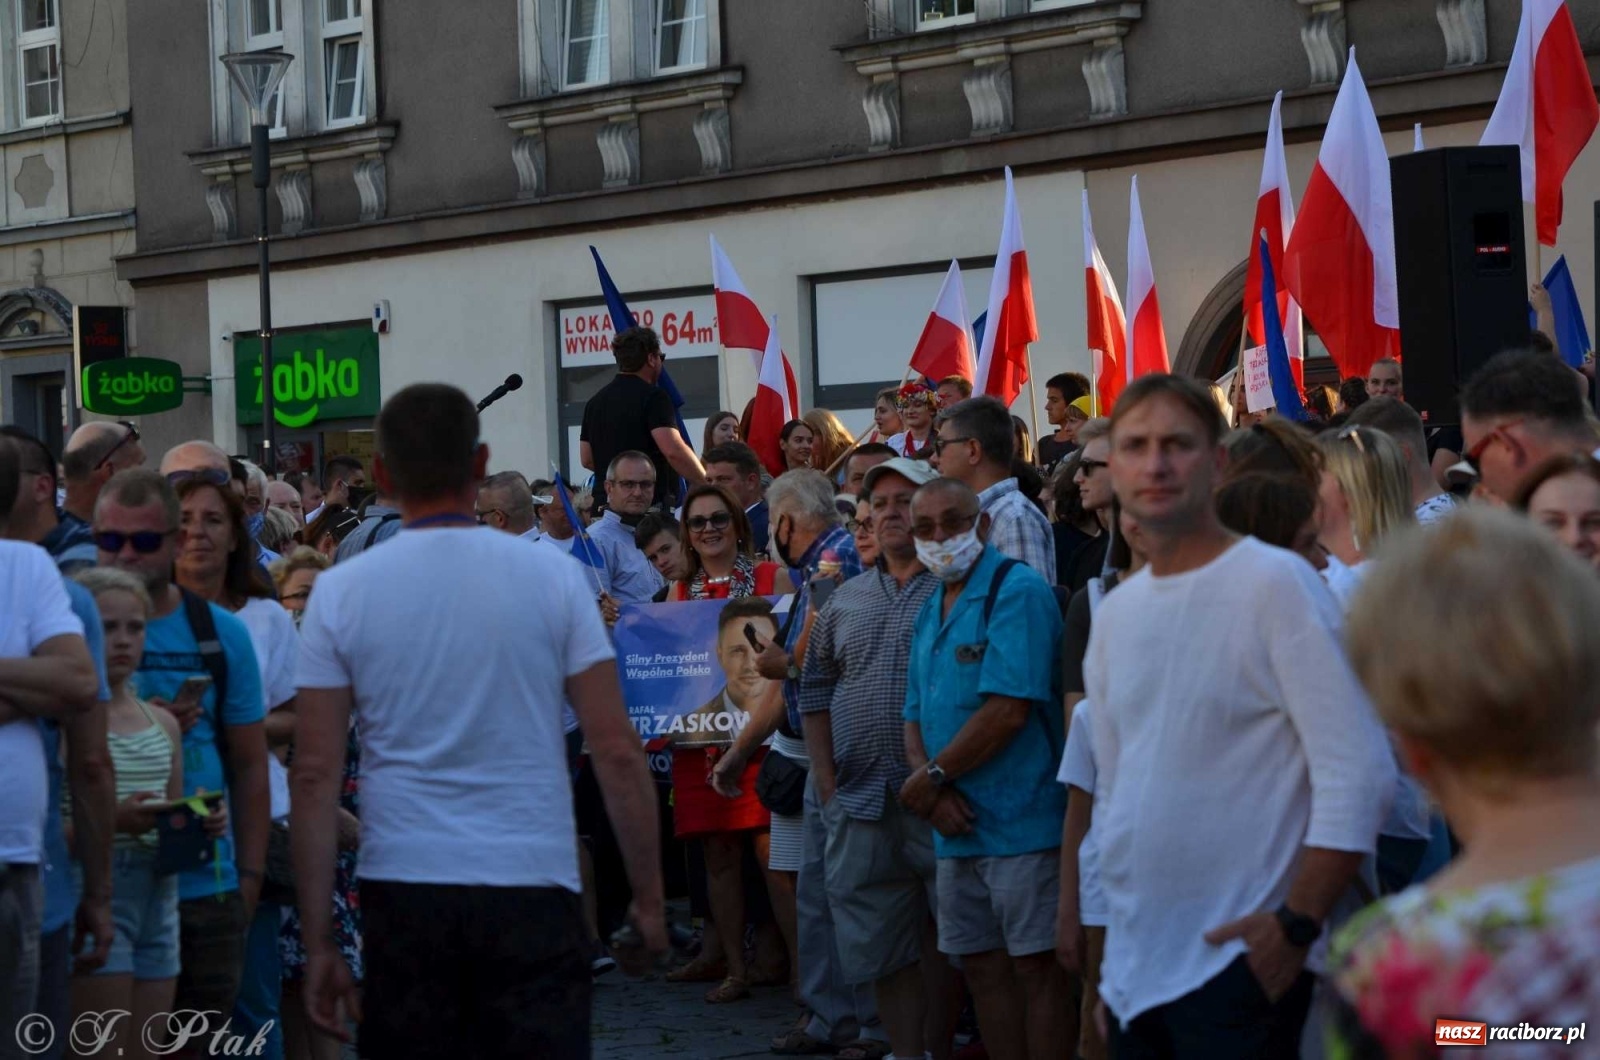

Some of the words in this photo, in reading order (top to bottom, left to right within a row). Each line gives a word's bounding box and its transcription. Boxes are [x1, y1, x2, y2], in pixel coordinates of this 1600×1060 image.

[565, 314, 612, 335] LOKA
[565, 335, 613, 355] WYNA
[98, 371, 174, 395] żabka
[625, 653, 653, 665] Silny
[654, 651, 709, 664] Prezydent
[626, 665, 673, 680] Wspólna
[675, 664, 712, 677] Polska
[629, 706, 655, 715] RAFAŁ
[629, 711, 751, 735] TRZASKOW
